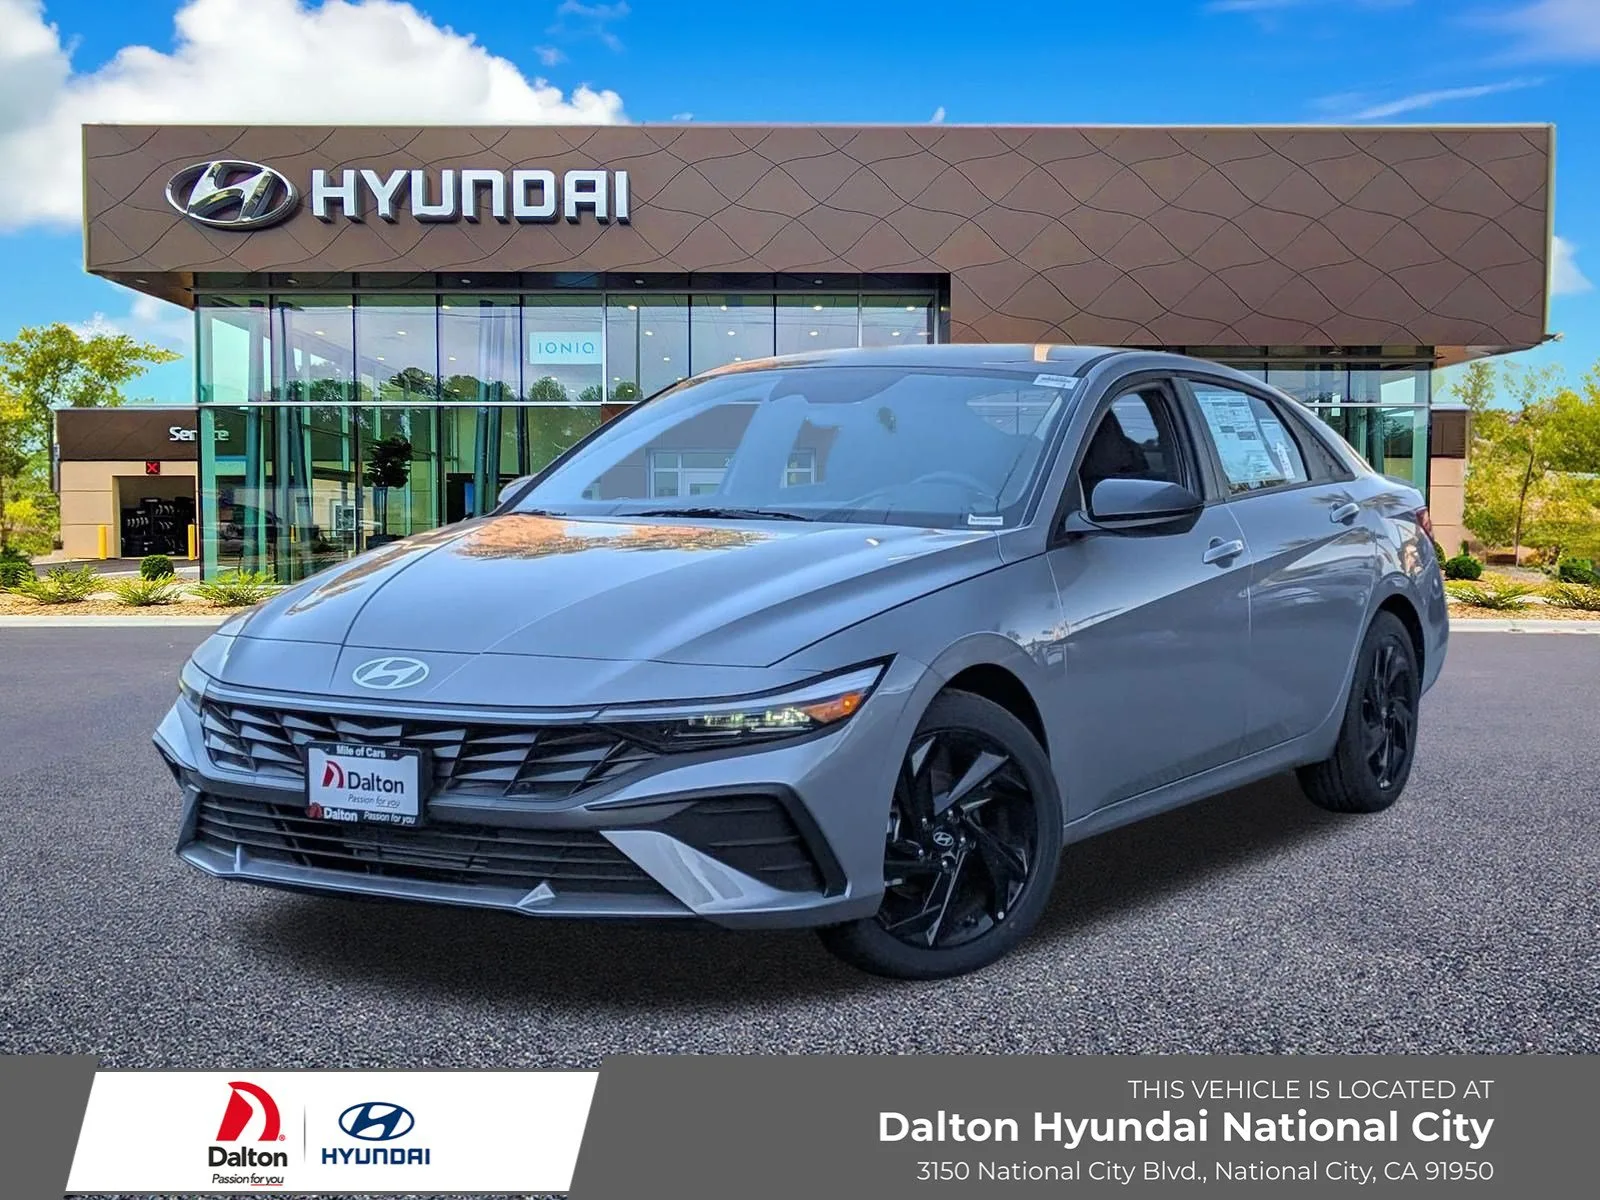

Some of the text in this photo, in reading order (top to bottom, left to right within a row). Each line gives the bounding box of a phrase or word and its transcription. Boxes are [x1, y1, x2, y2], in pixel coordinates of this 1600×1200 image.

[312, 169, 630, 220] HYUNDAI
[538, 342, 594, 354] IONIQ
[336, 745, 386, 758] Mile of Cars
[347, 771, 404, 794] Dalton
[348, 793, 375, 804] Passion
[375, 796, 386, 806] for
[323, 807, 358, 822] Dalton
[363, 811, 416, 825] Passion for you
